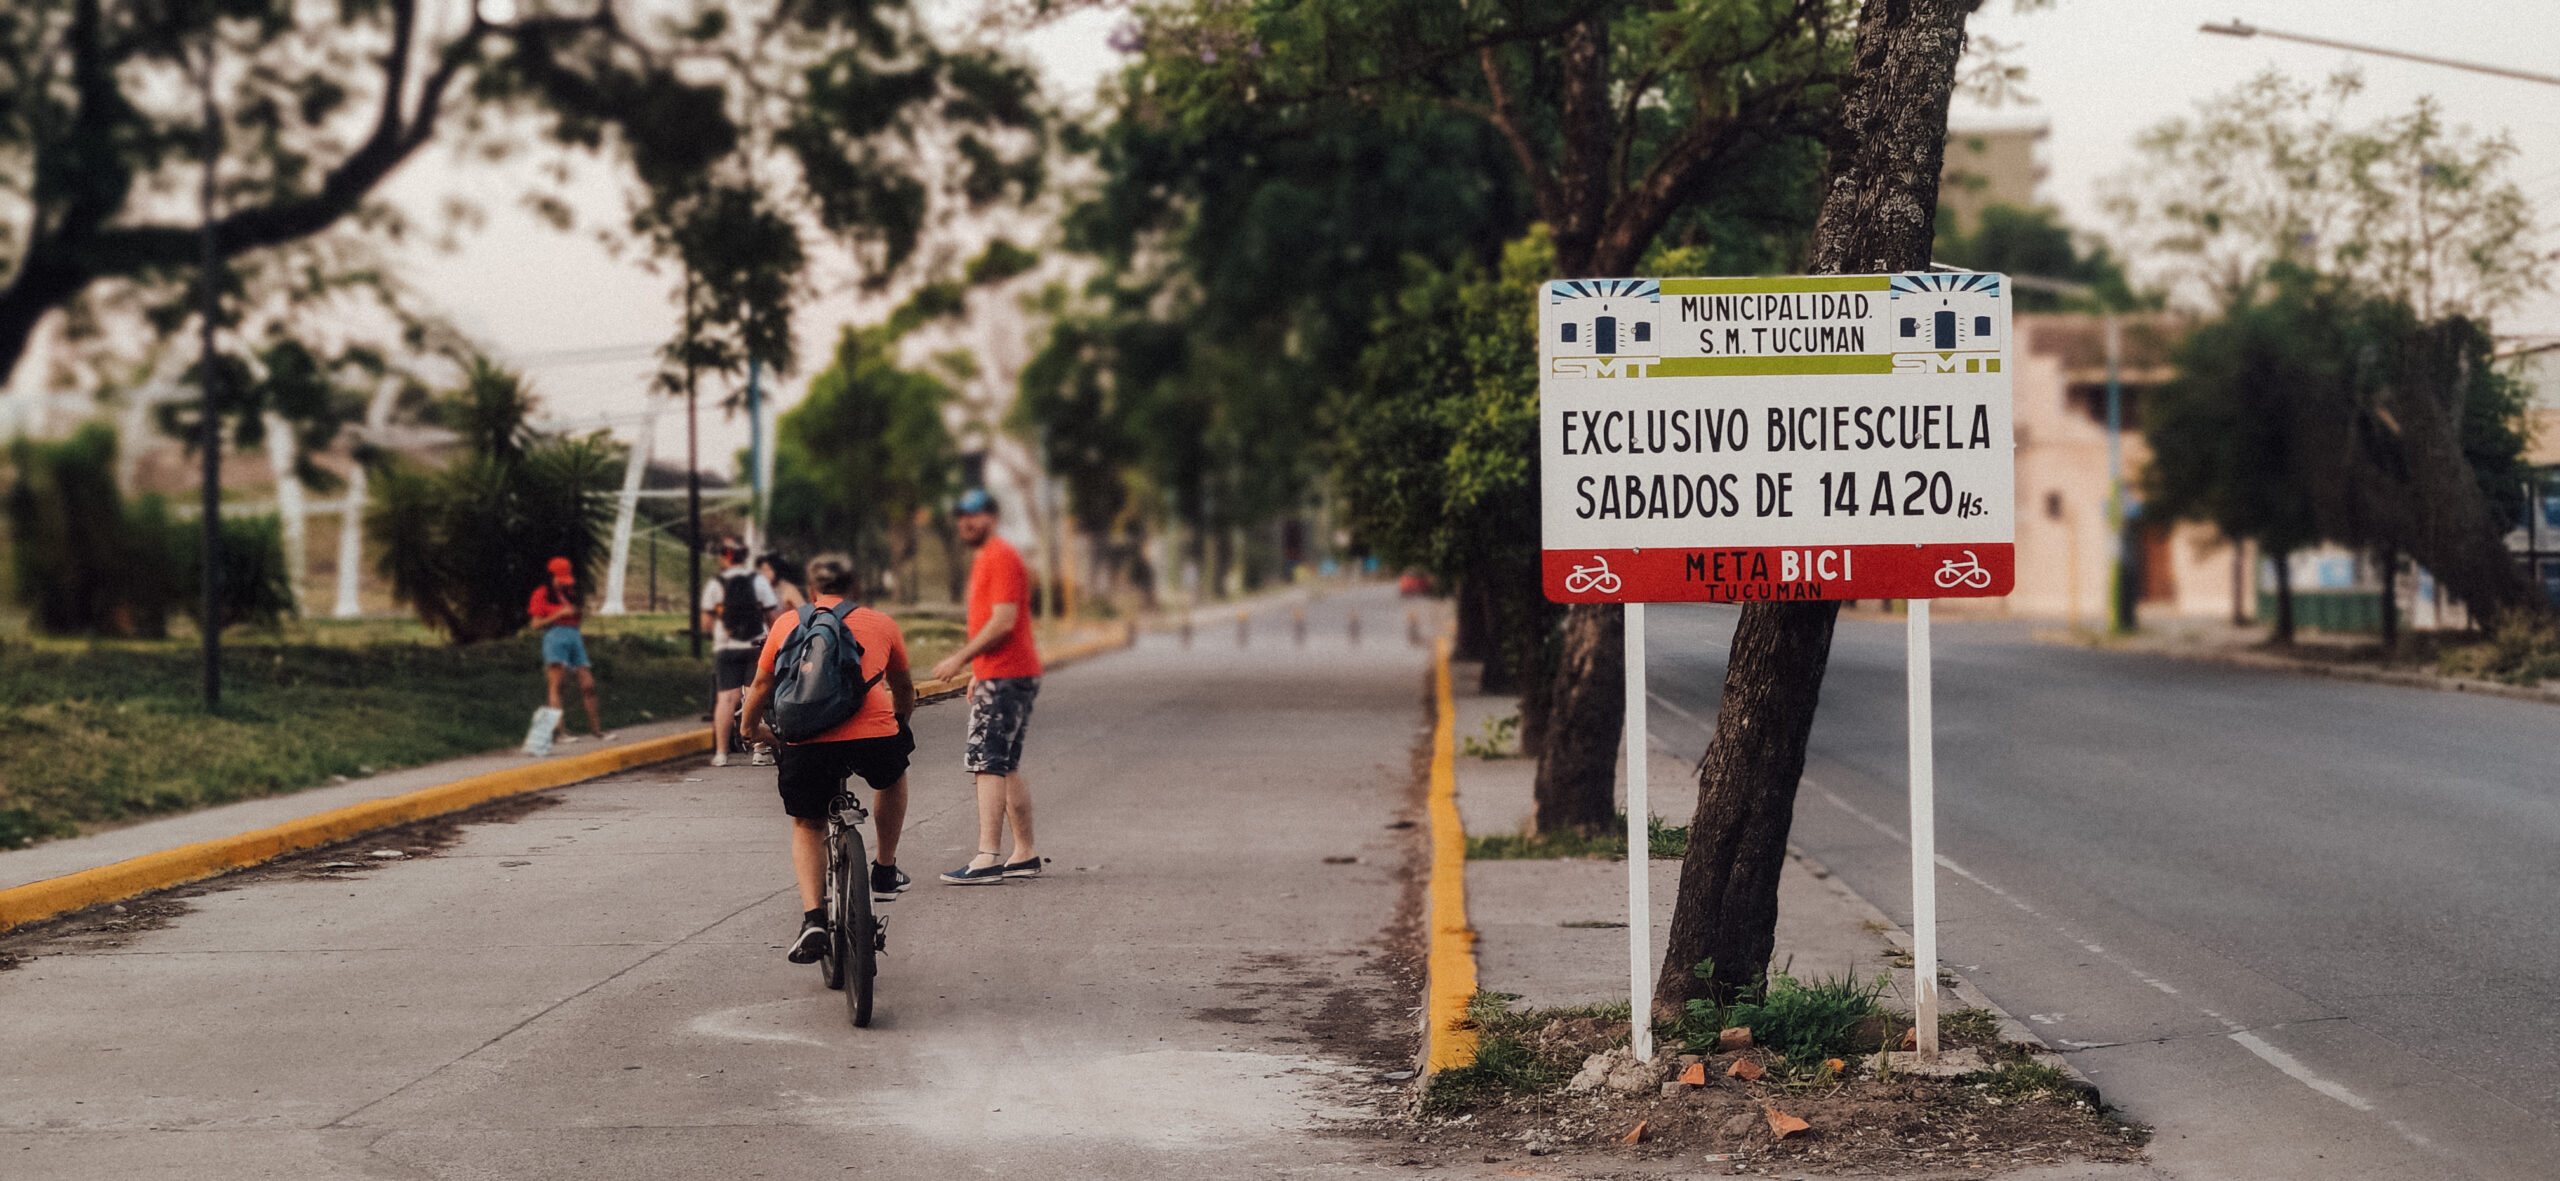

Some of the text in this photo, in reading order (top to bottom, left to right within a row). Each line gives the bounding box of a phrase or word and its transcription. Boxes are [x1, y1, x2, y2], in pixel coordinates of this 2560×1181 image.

[1681, 294, 1873, 322] MUNICIPALIDAD.
[1751, 326, 1865, 354] TUCUMAN
[1552, 356, 1660, 379] SMT
[1891, 352, 2000, 374] SMT
[1562, 403, 1991, 456] EXCLUSIVO BICIESCUELA
[1575, 473, 1740, 520] SABADOS
[1755, 472, 1793, 518] DE
[1819, 471, 1860, 517] 14
[1869, 470, 1896, 517] A
[1902, 470, 1954, 516] 20
[1685, 549, 1852, 582] META BICI
